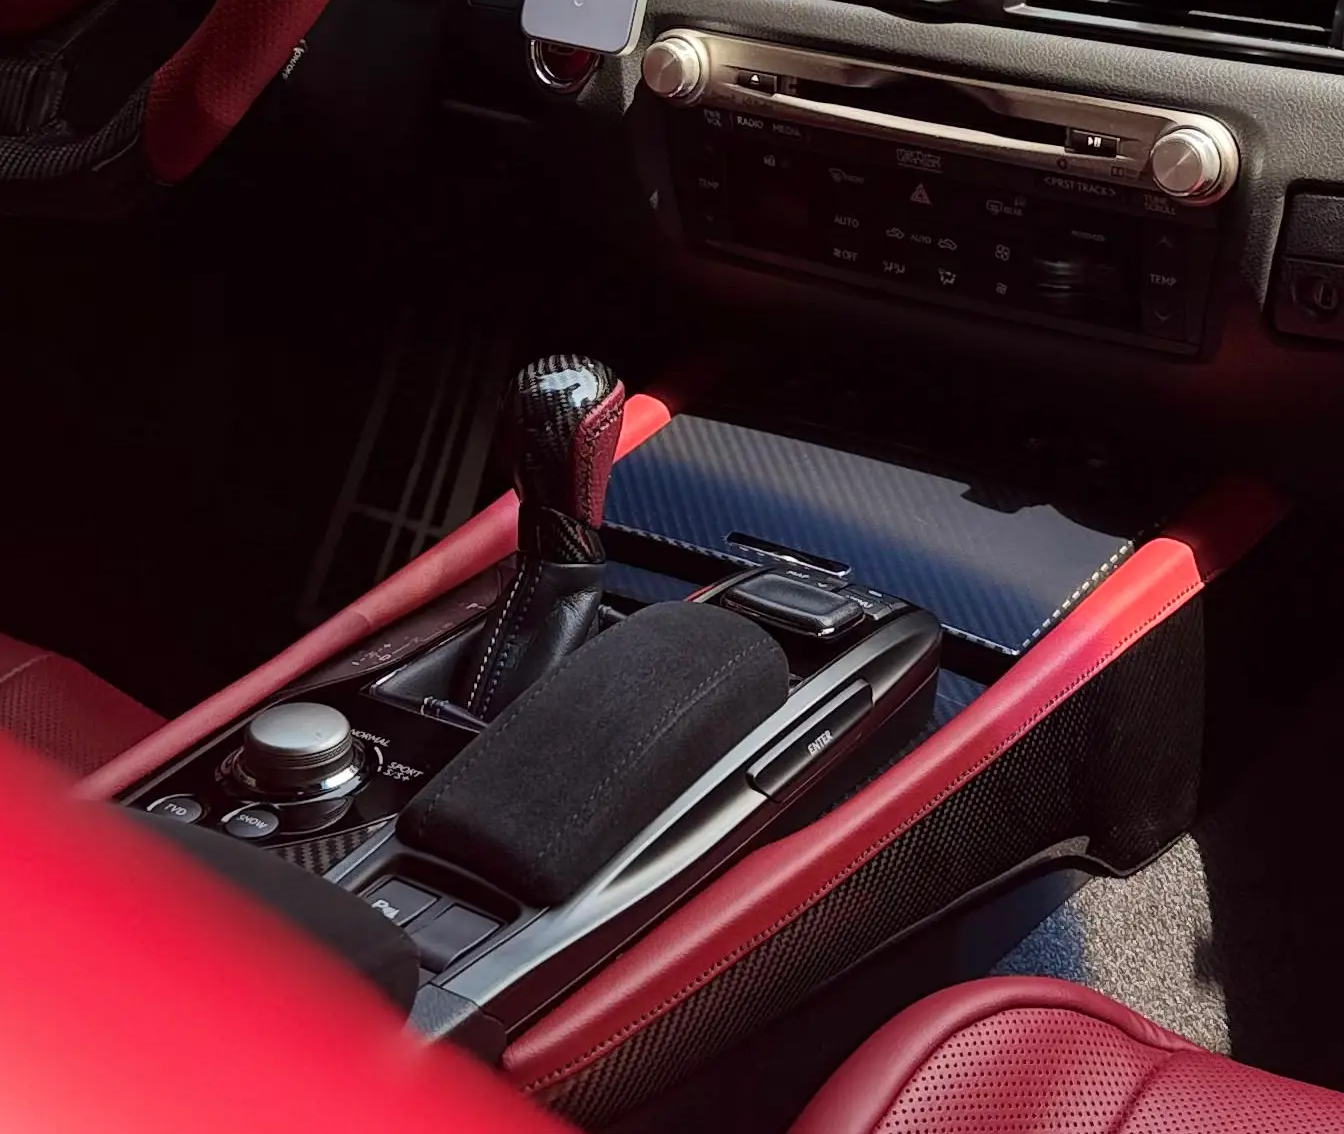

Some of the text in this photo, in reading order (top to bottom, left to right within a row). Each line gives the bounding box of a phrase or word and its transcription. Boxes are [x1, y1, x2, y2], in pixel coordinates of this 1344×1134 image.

[736, 115, 764, 130] RADIO
[772, 122, 802, 137] MEDIA
[834, 214, 860, 229] AUTO
[909, 233, 932, 245] AUTO
[842, 249, 859, 263] OFF
[1149, 273, 1178, 288] TEMP
[351, 728, 391, 747] NORMAL
[807, 729, 834, 755] ENTER
[387, 761, 425, 778] SPORT
[164, 803, 188, 816] TVD
[237, 813, 269, 829] SNOW
